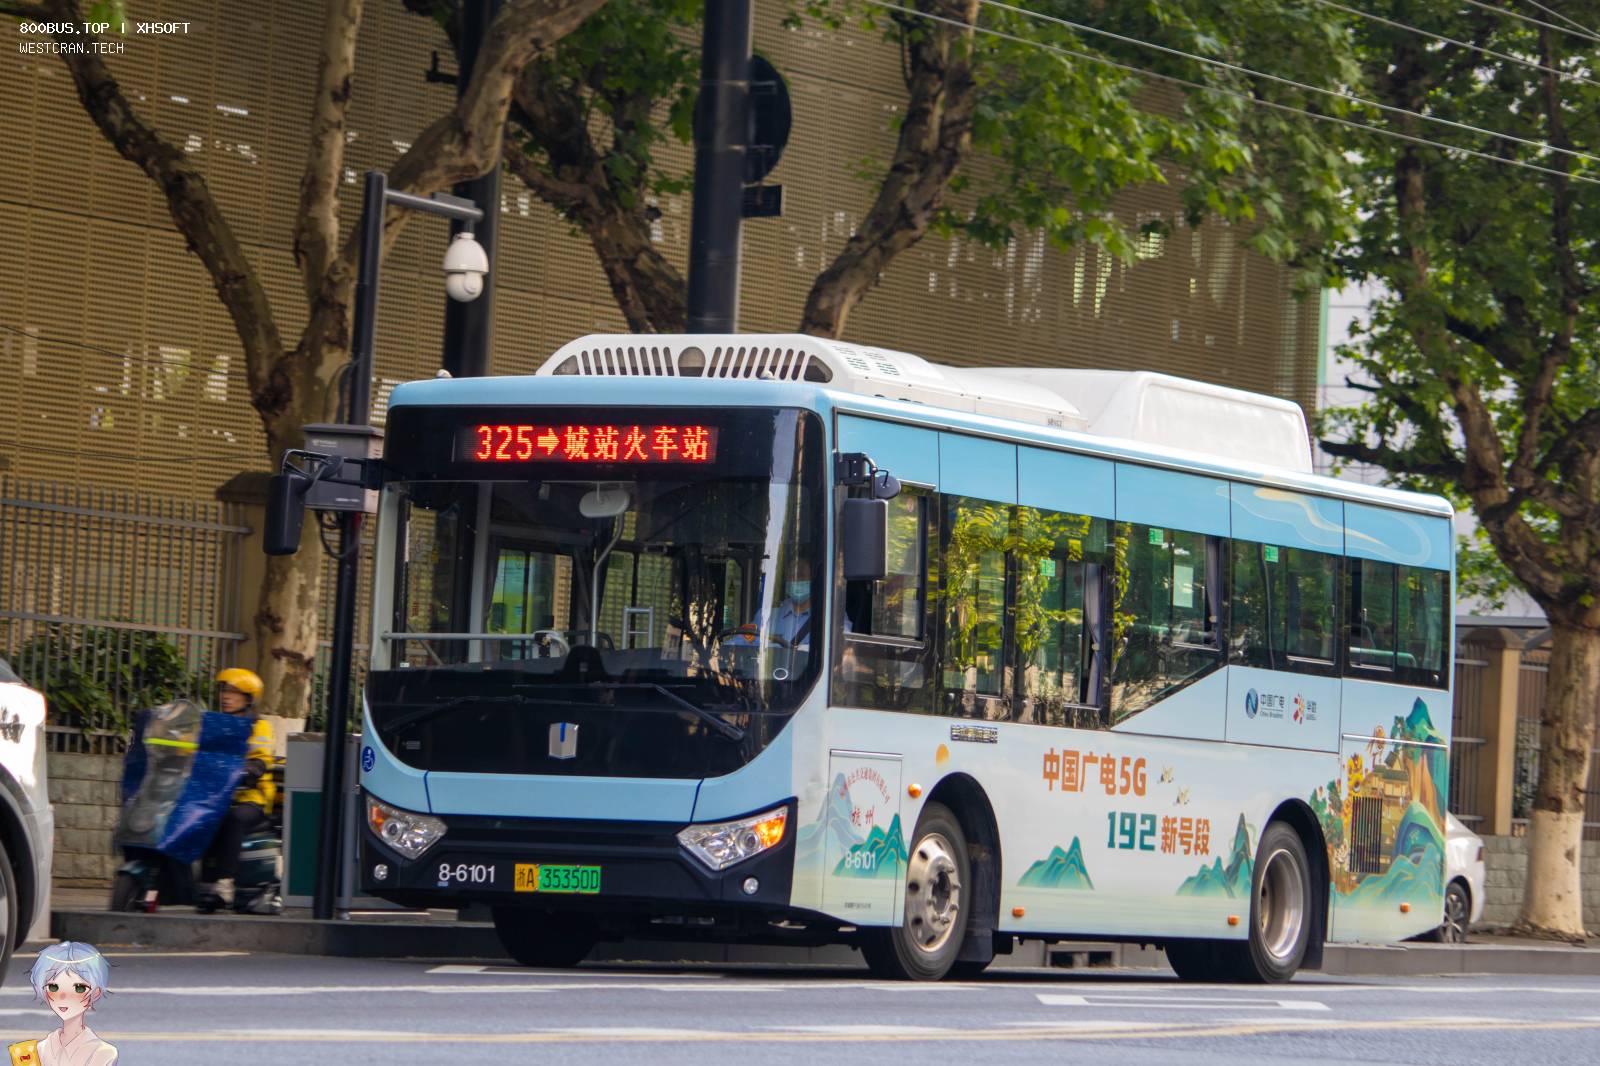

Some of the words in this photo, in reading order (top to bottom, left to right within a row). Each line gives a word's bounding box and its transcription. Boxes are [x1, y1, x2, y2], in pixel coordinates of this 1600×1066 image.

[477, 425, 534, 460] 325
[563, 425, 710, 460] 城站火车站
[1042, 747, 1147, 797] 中国广电5G
[851, 804, 876, 827] 杭州
[1107, 811, 1157, 851] 192
[1160, 815, 1211, 856] 新号段
[438, 863, 496, 884] 8-6101
[844, 851, 876, 870] 8-6101
